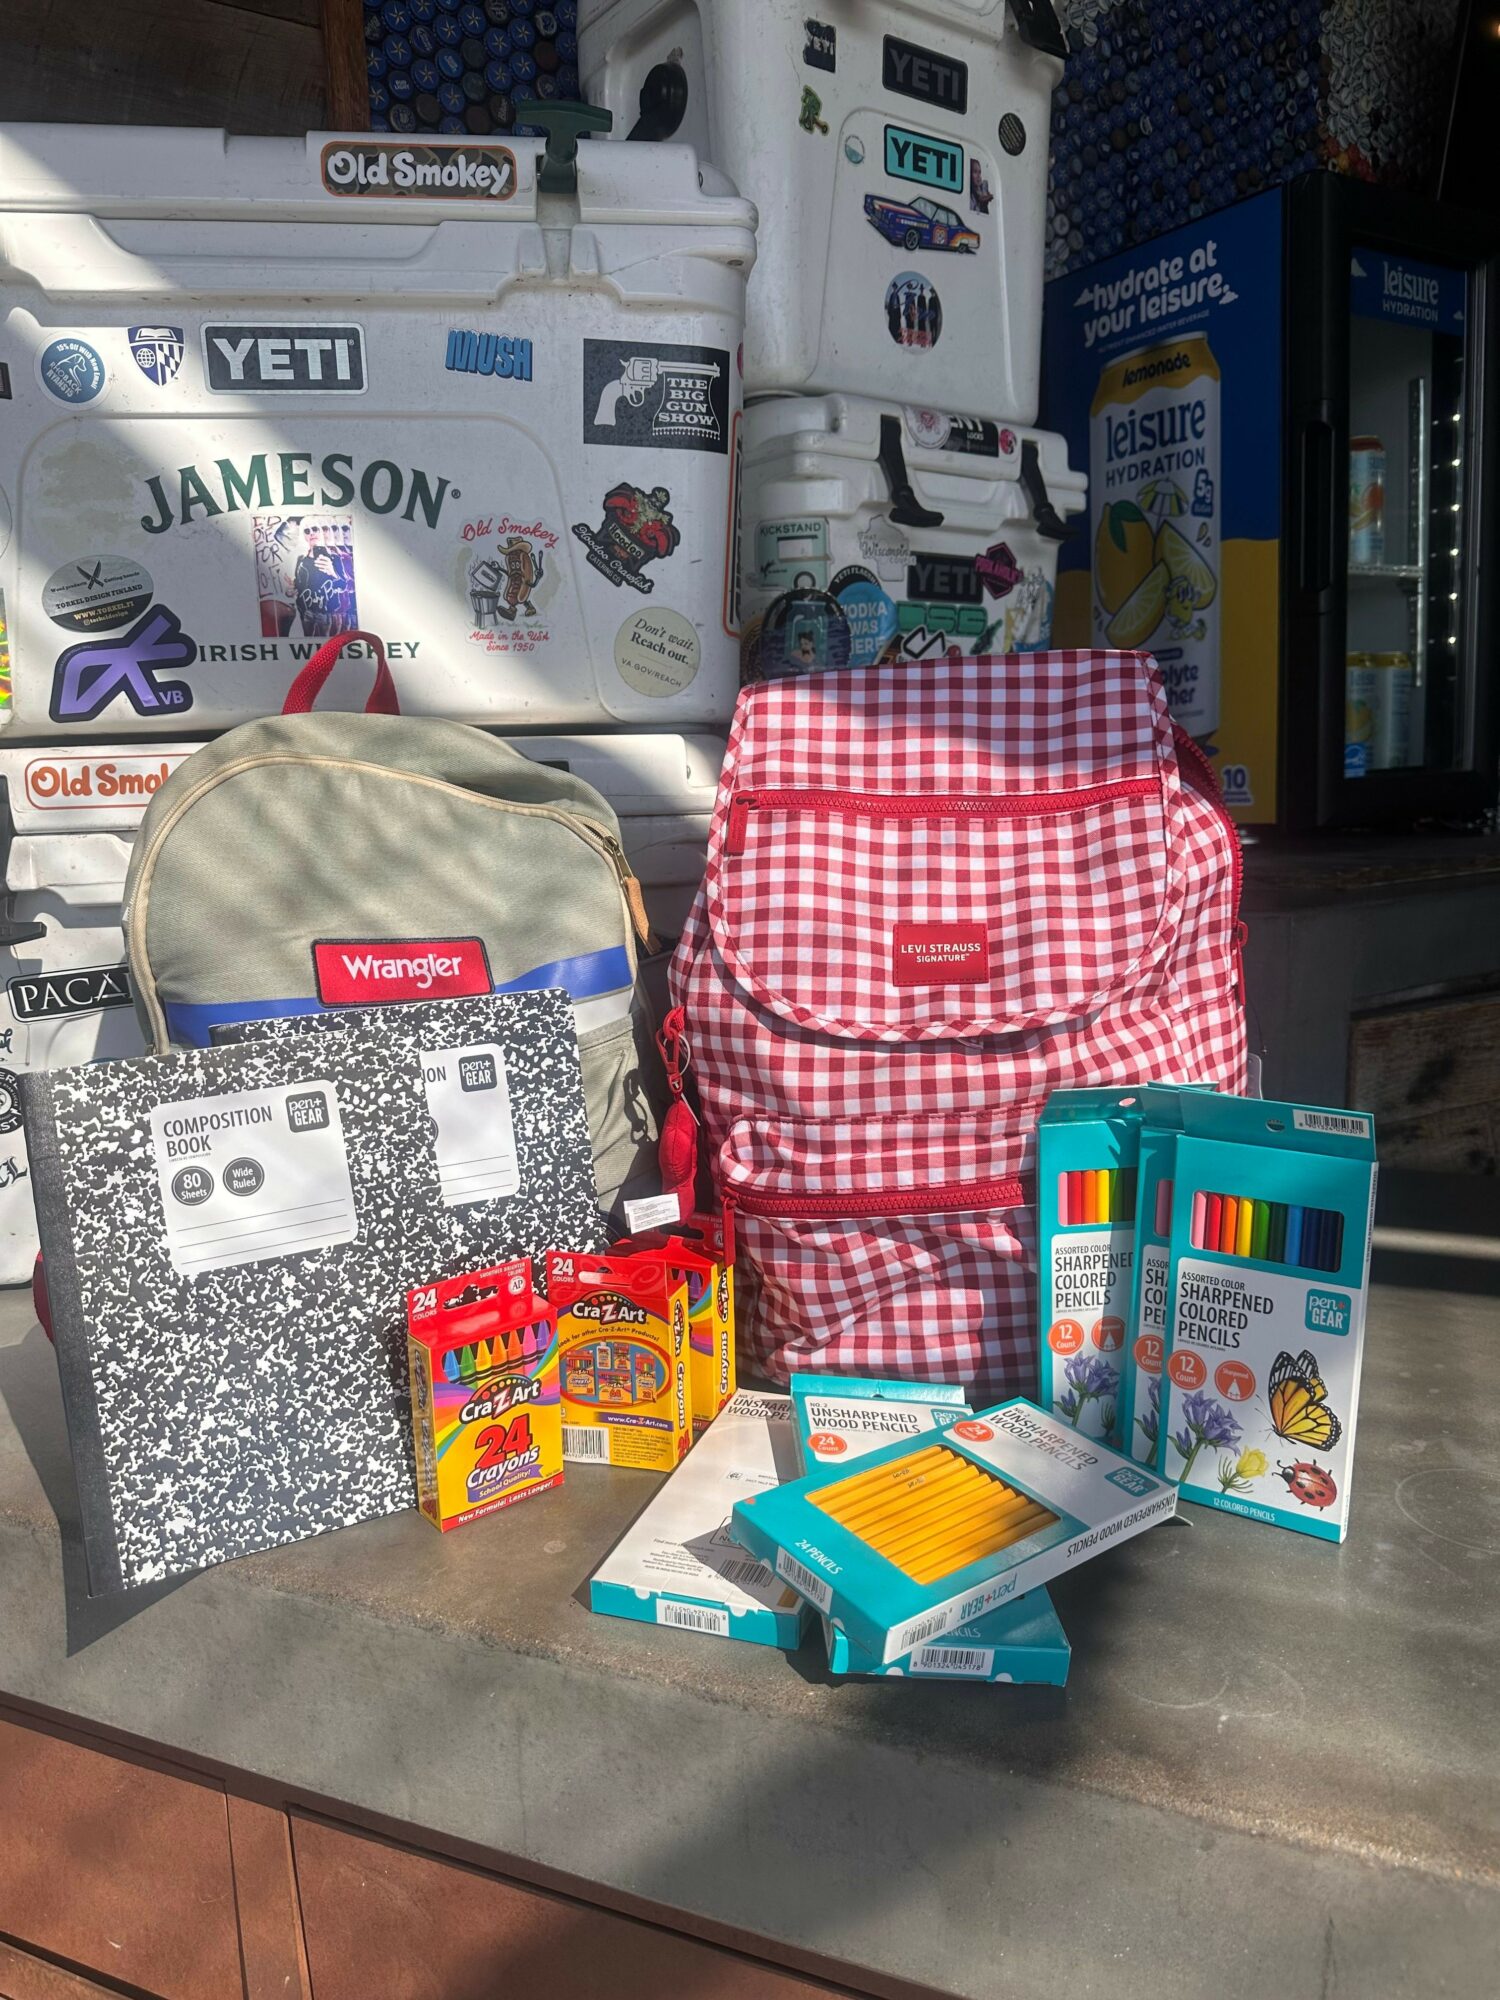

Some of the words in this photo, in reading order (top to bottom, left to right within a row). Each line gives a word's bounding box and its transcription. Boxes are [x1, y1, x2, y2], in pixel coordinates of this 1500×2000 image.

[889, 49, 960, 101] YETI
[891, 136, 957, 182] YETI
[328, 151, 389, 185] Old
[393, 151, 510, 195] Smokey
[1093, 256, 1183, 312] hydrate
[1189, 240, 1217, 274] at
[1383, 261, 1439, 305] leisure
[1382, 299, 1439, 322] HYDRATION
[1084, 304, 1136, 349] your
[212, 338, 351, 381] YETI
[1123, 352, 1191, 387] lemonade
[50, 361, 82, 394] RHOBACK
[667, 377, 708, 390] THE
[670, 390, 704, 401] BIG
[666, 401, 708, 413] GUN
[659, 412, 715, 426] SHOW
[967, 431, 984, 441] LOCKS
[1106, 399, 1206, 462] leisure
[1106, 447, 1205, 488] HYDRATION
[460, 518, 493, 541] Old
[498, 517, 559, 549] Smokey
[760, 522, 822, 537] KICKSTAND
[575, 526, 609, 560] Hoodoo
[862, 542, 911, 560] Wisconsin
[589, 553, 614, 578] CATERING
[610, 560, 653, 592] Crawfish
[835, 567, 852, 584] YETI
[915, 564, 977, 596] YETI
[56, 598, 85, 609] TORKEL
[85, 592, 111, 602] DESIGN
[112, 584, 143, 596] FINLAND
[73, 601, 134, 620] WWW.TORKEL.FI
[470, 630, 494, 641] Made
[498, 631, 508, 641] in
[512, 630, 524, 641] the
[527, 630, 550, 641] USA
[634, 618, 666, 638] Don't
[668, 634, 694, 652] wait.
[848, 621, 878, 635] WAS
[200, 643, 280, 662] IRISH
[486, 642, 509, 651] Since
[513, 642, 535, 651] 1950
[631, 631, 666, 655] Reach
[667, 649, 689, 665] out.
[622, 658, 681, 687] VA.GOV/REACH
[159, 690, 184, 705] VB
[31, 766, 93, 798] Old
[1223, 768, 1247, 791] 10
[901, 944, 926, 954] LEVI
[929, 943, 981, 953] STRAUSS
[916, 954, 966, 963] SIGNATURE
[341, 953, 462, 989] Wrangler
[466, 1071, 492, 1087] GEAR
[164, 1105, 273, 1138] COMPOSITION
[294, 1108, 324, 1127] GEAR
[166, 1134, 212, 1158] BOOK
[183, 1172, 202, 1189] 80
[232, 1167, 254, 1178] Wide
[233, 1177, 256, 1189] Ruled
[181, 1188, 208, 1200] Sheets
[1055, 1246, 1089, 1255] ASSORTED
[1090, 1244, 1111, 1254] COLOR
[552, 1257, 574, 1276] 24
[1055, 1271, 1116, 1290] COLORED
[1181, 1271, 1220, 1287] ASSORTED
[1221, 1278, 1245, 1291] COLOR
[412, 1288, 438, 1314] 24
[1056, 1289, 1111, 1309] PENCILS
[1180, 1281, 1274, 1315] SHARPENED
[413, 1310, 438, 1321] COLORS
[1179, 1301, 1248, 1330] COLORED
[1311, 1309, 1343, 1329] GEAR
[581, 1328, 597, 1336] other
[631, 1328, 660, 1342] Products!
[1059, 1324, 1072, 1340] 12
[1178, 1321, 1240, 1349] PENCILS
[1056, 1340, 1076, 1349] Count
[1146, 1340, 1160, 1357] 12
[720, 1331, 730, 1394] Crayons
[1142, 1356, 1162, 1367] Count
[1179, 1355, 1194, 1374] 12
[1175, 1371, 1197, 1385] Count
[676, 1361, 685, 1430] Crayons
[727, 1406, 768, 1418] WOOD
[811, 1407, 918, 1424] UNSHARPENED
[812, 1417, 859, 1429] WOOD
[862, 1421, 921, 1434] PENCILS
[966, 1424, 988, 1436] 24
[475, 1413, 533, 1470] 24
[818, 1444, 838, 1452] Count
[819, 1436, 835, 1445] 24
[990, 1414, 1032, 1442] WOOD
[1030, 1438, 1087, 1472] PENCILS
[1003, 1409, 1098, 1466] UNSHARPENED
[467, 1446, 540, 1489] Crayons
[479, 1482, 502, 1498] School
[503, 1470, 531, 1487] Quality!
[1113, 1472, 1144, 1493] GEAR
[458, 1513, 474, 1523] New
[475, 1500, 506, 1516] Formula!
[509, 1491, 527, 1503] Lasts
[528, 1480, 554, 1495] Longer!
[1124, 1493, 1176, 1528] UNSHARPENED
[1213, 1497, 1220, 1506] 12
[1220, 1499, 1249, 1517] COLORED
[1249, 1505, 1276, 1522] PENCILS
[1098, 1518, 1123, 1543] WOOD
[1067, 1528, 1097, 1559] PENCILS
[794, 1539, 809, 1550] 24
[806, 1546, 844, 1575] PENCILS
